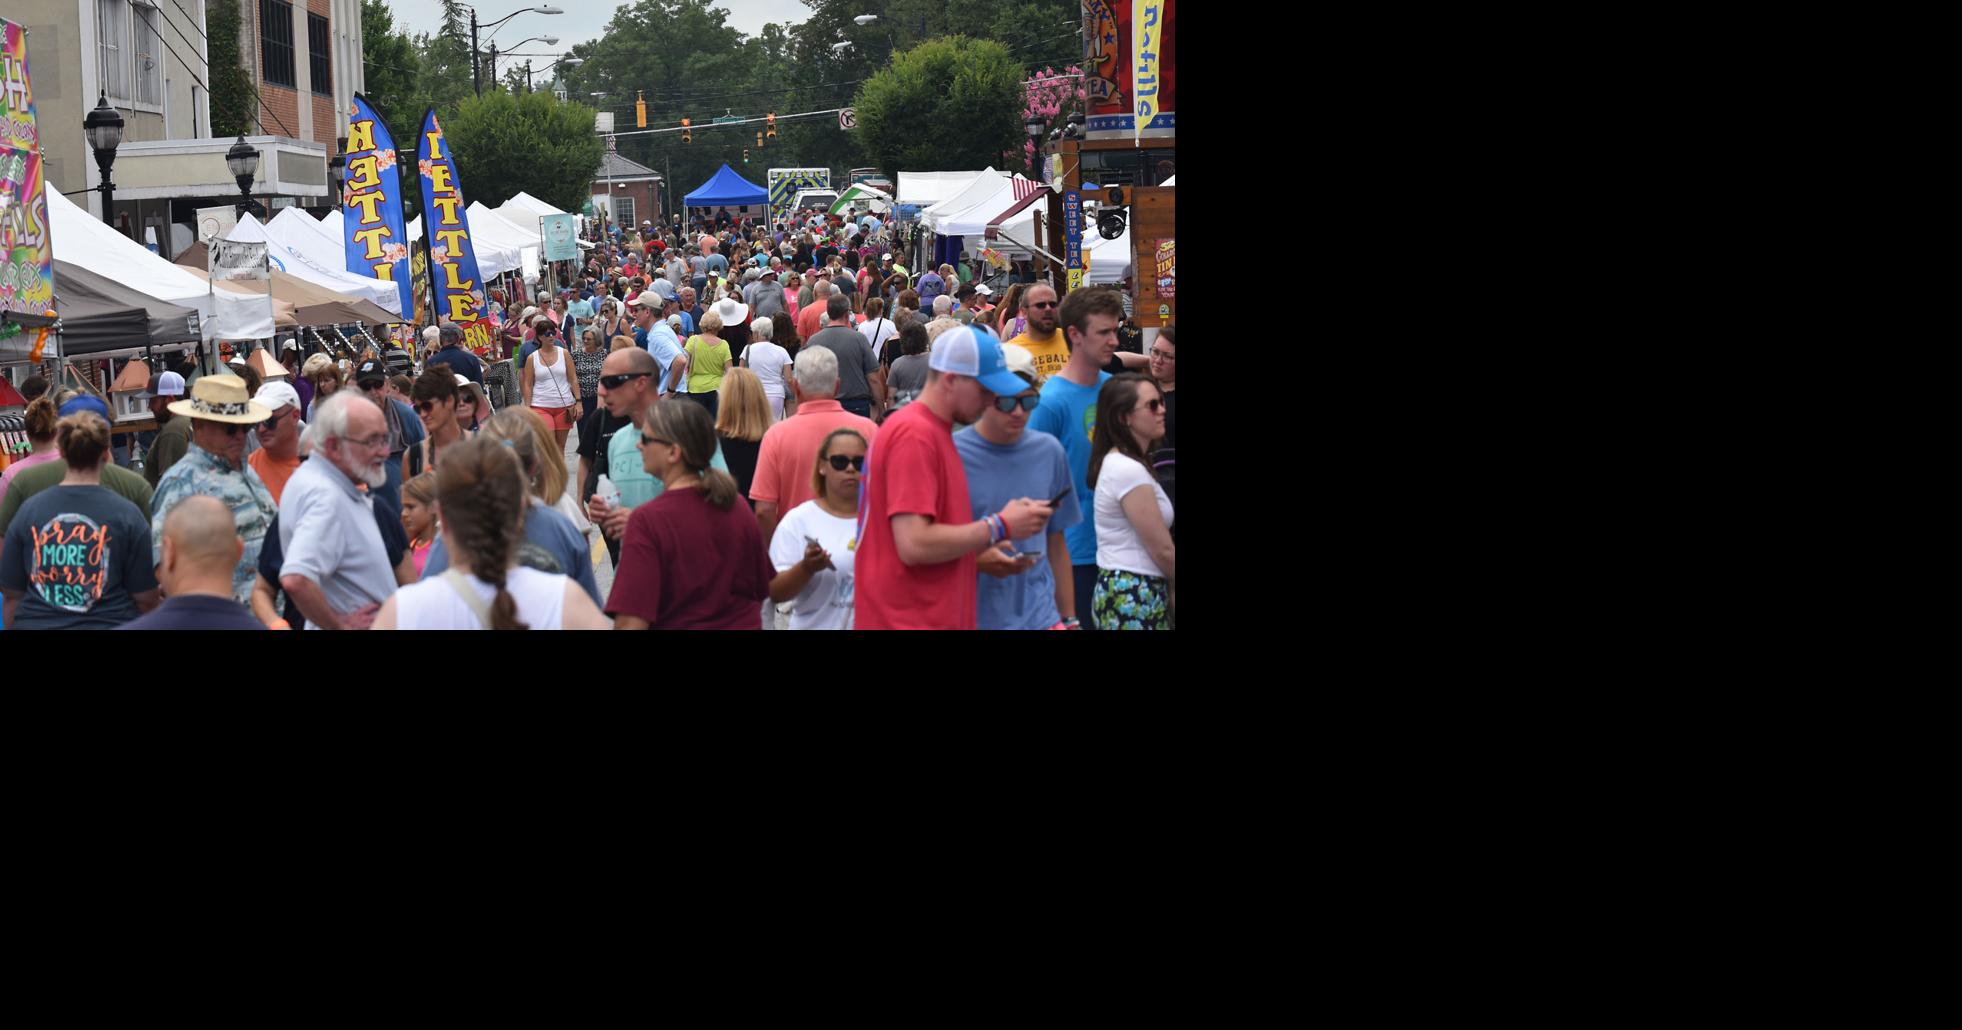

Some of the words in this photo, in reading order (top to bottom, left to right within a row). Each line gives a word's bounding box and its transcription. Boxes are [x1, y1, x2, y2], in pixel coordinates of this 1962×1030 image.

[1067, 194, 1078, 235] SWEET
[1070, 242, 1079, 266] TEA
[32, 521, 111, 567] pray
[42, 544, 87, 567] MORE
